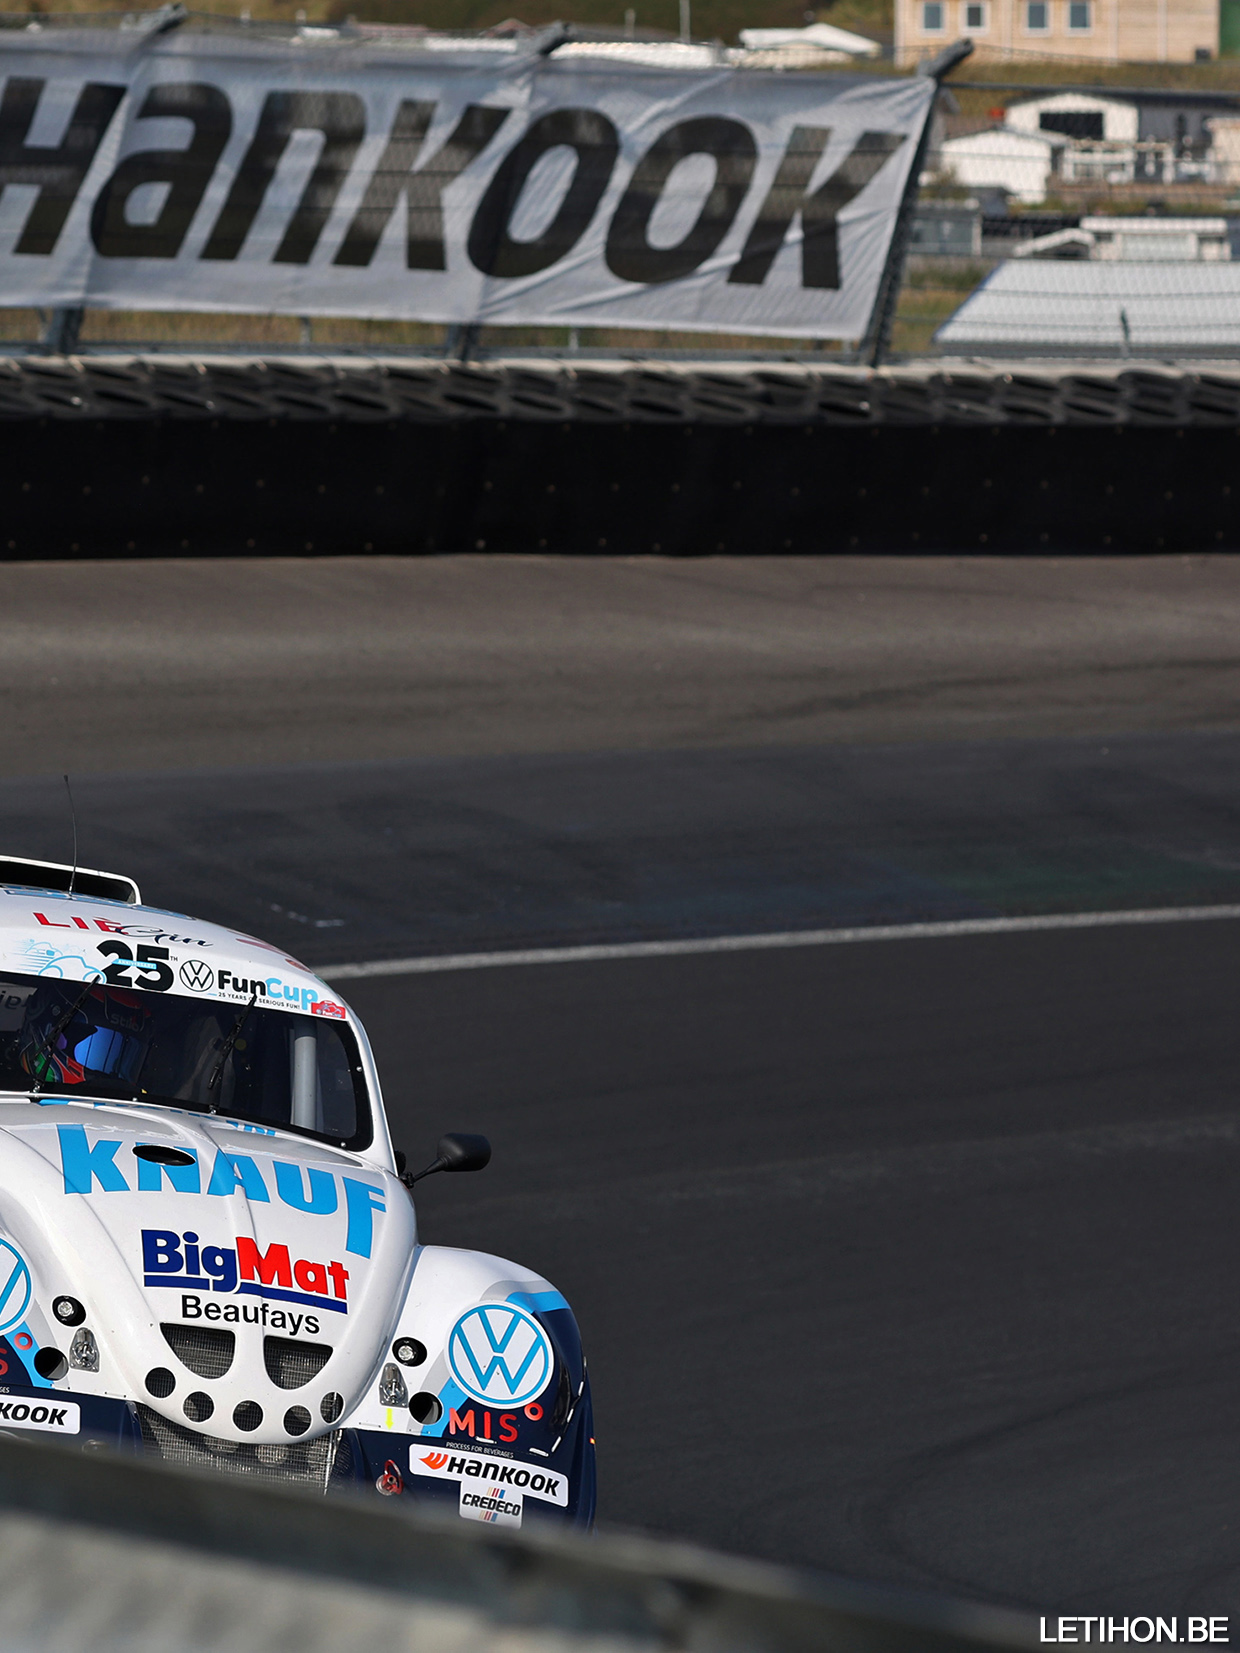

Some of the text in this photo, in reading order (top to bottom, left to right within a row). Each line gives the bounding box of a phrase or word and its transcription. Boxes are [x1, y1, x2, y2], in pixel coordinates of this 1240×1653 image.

[96, 940, 174, 993] 25
[218, 970, 318, 1010] FunCup
[228, 992, 247, 1001] YEARS
[57, 1124, 387, 1259] KNAUF
[141, 1229, 349, 1299] BigMat
[182, 1295, 320, 1335] Beaufays
[446, 1442, 514, 1459] PROCESS FOR BEVERAGES
[461, 1493, 521, 1516] CREDECO
